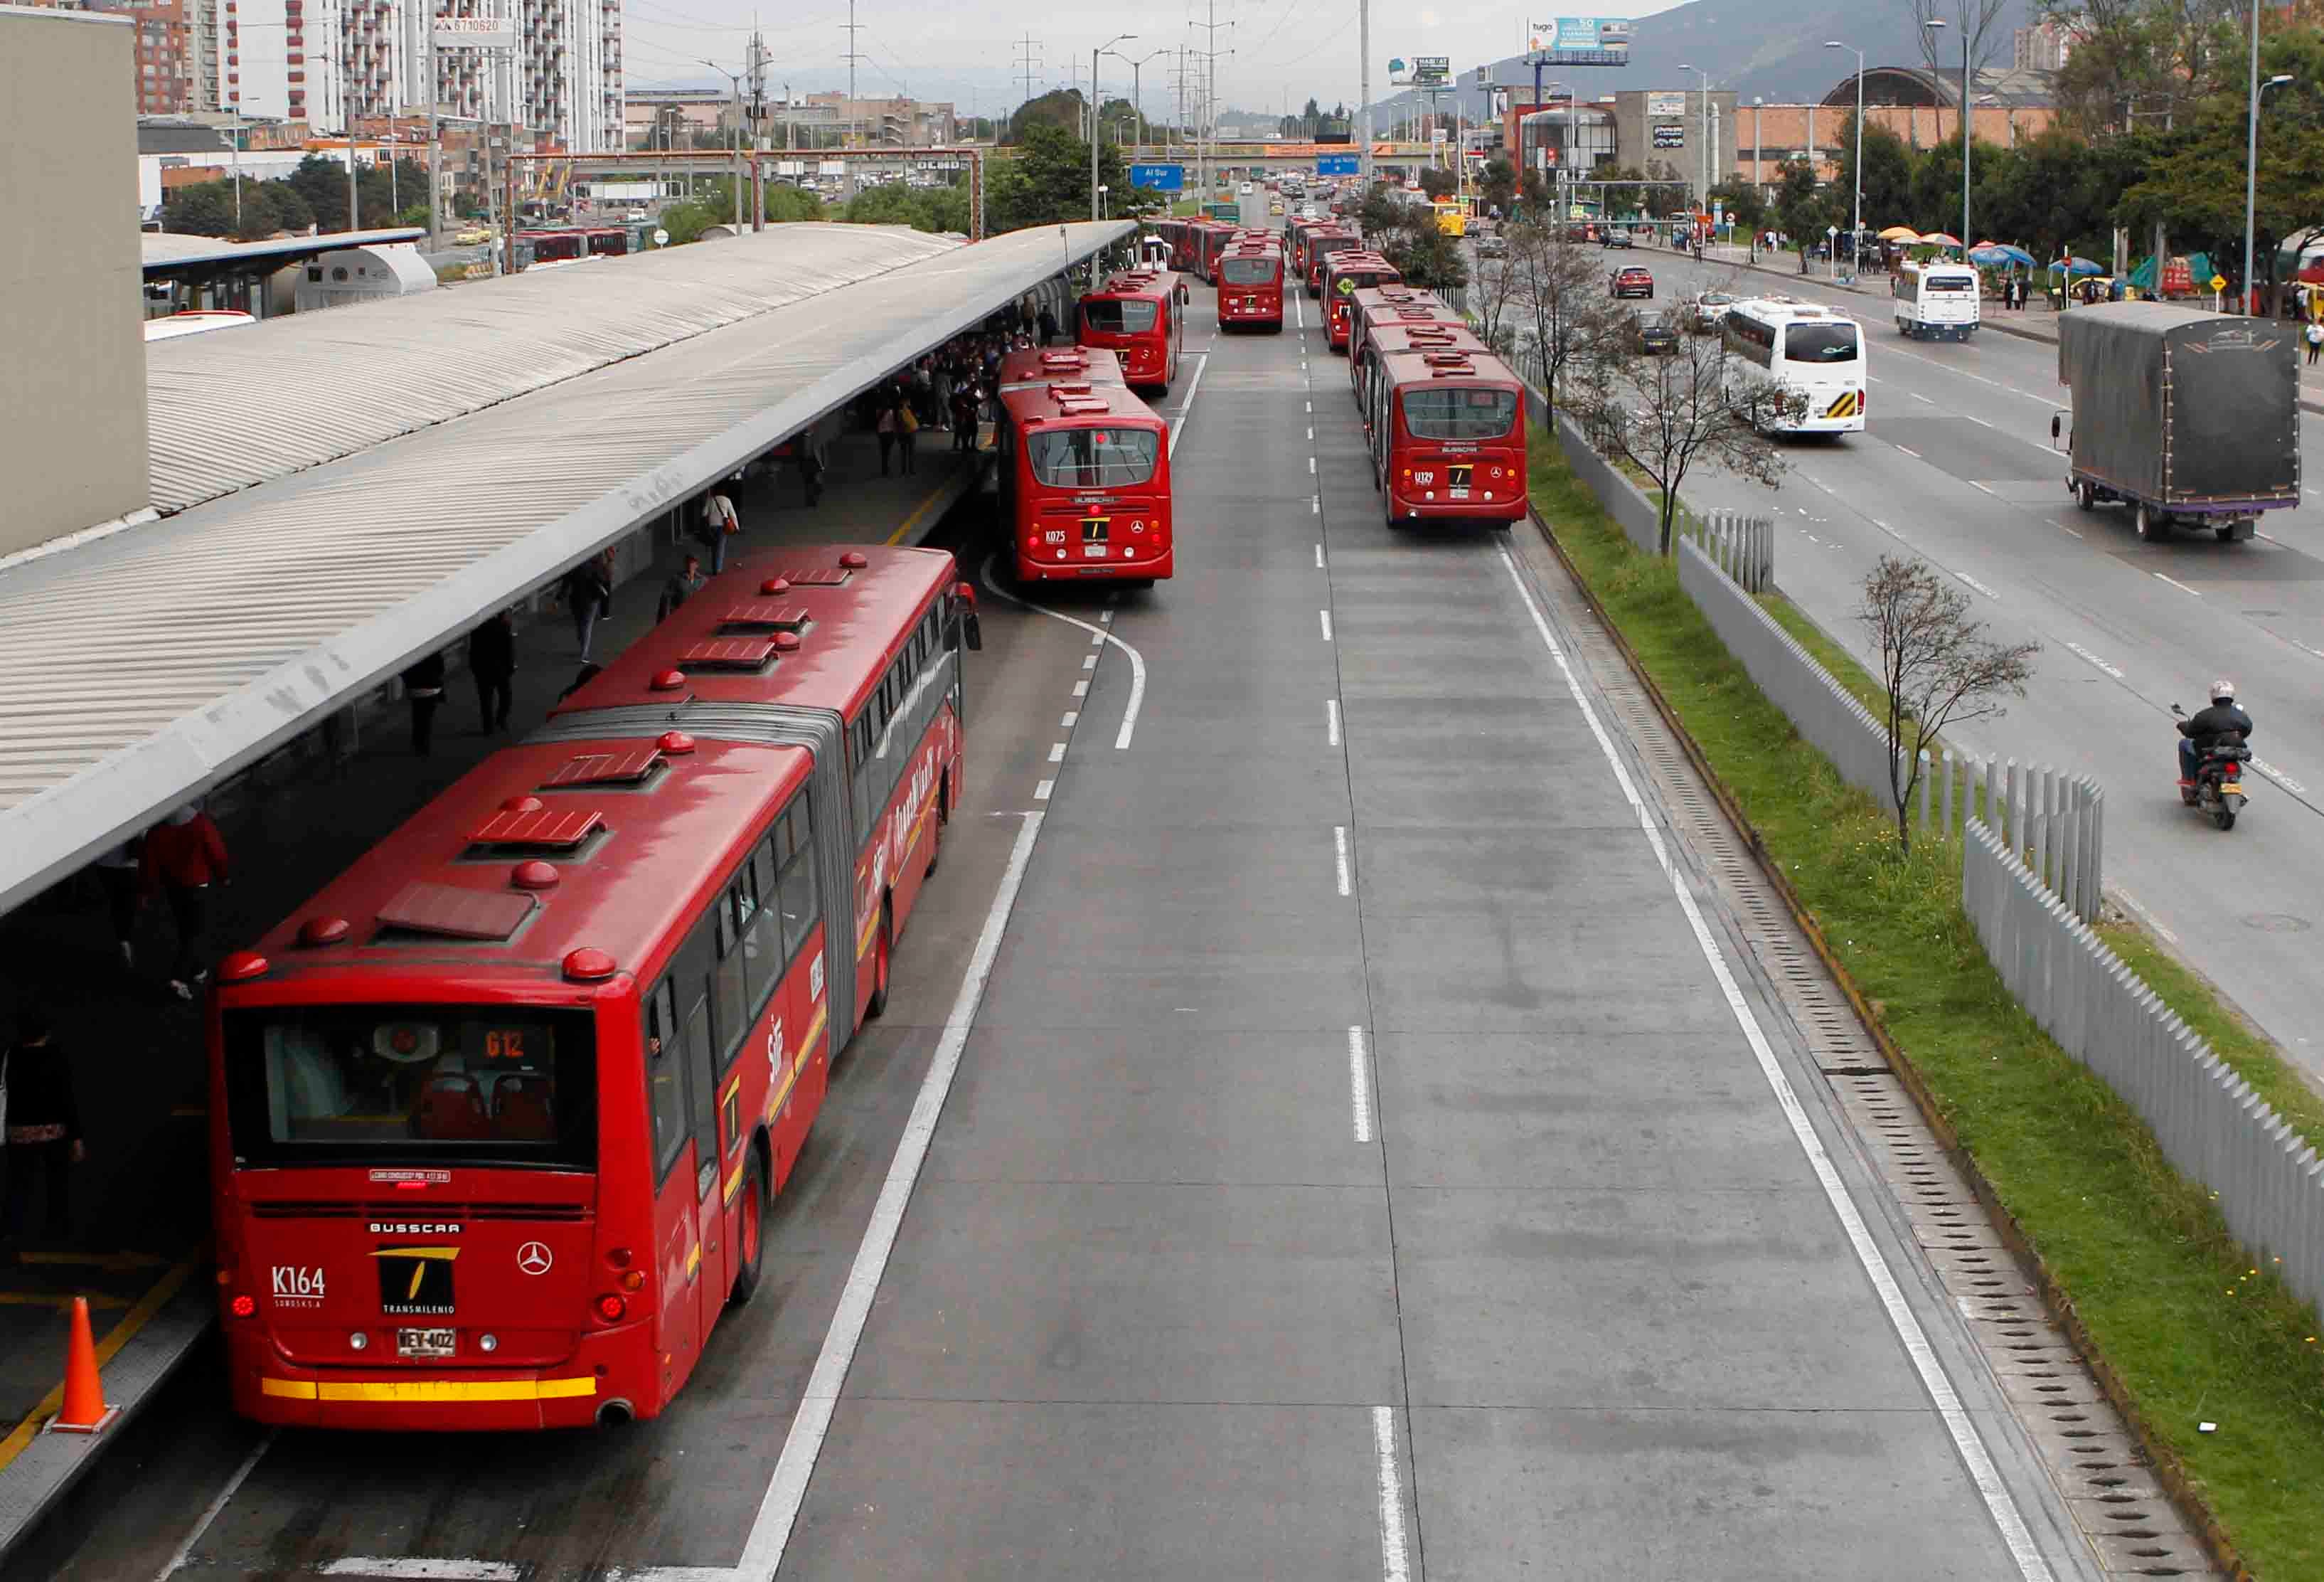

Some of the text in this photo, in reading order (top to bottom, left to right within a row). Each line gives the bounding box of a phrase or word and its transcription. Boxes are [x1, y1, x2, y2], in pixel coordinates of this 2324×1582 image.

[1533, 23, 1553, 33] tugo
[1414, 472, 1434, 482] U129
[1045, 531, 1065, 542] K075
[369, 1223, 461, 1233] BUSSCAR
[272, 1265, 325, 1295] K164
[383, 1304, 455, 1315] TRANSMILENIO
